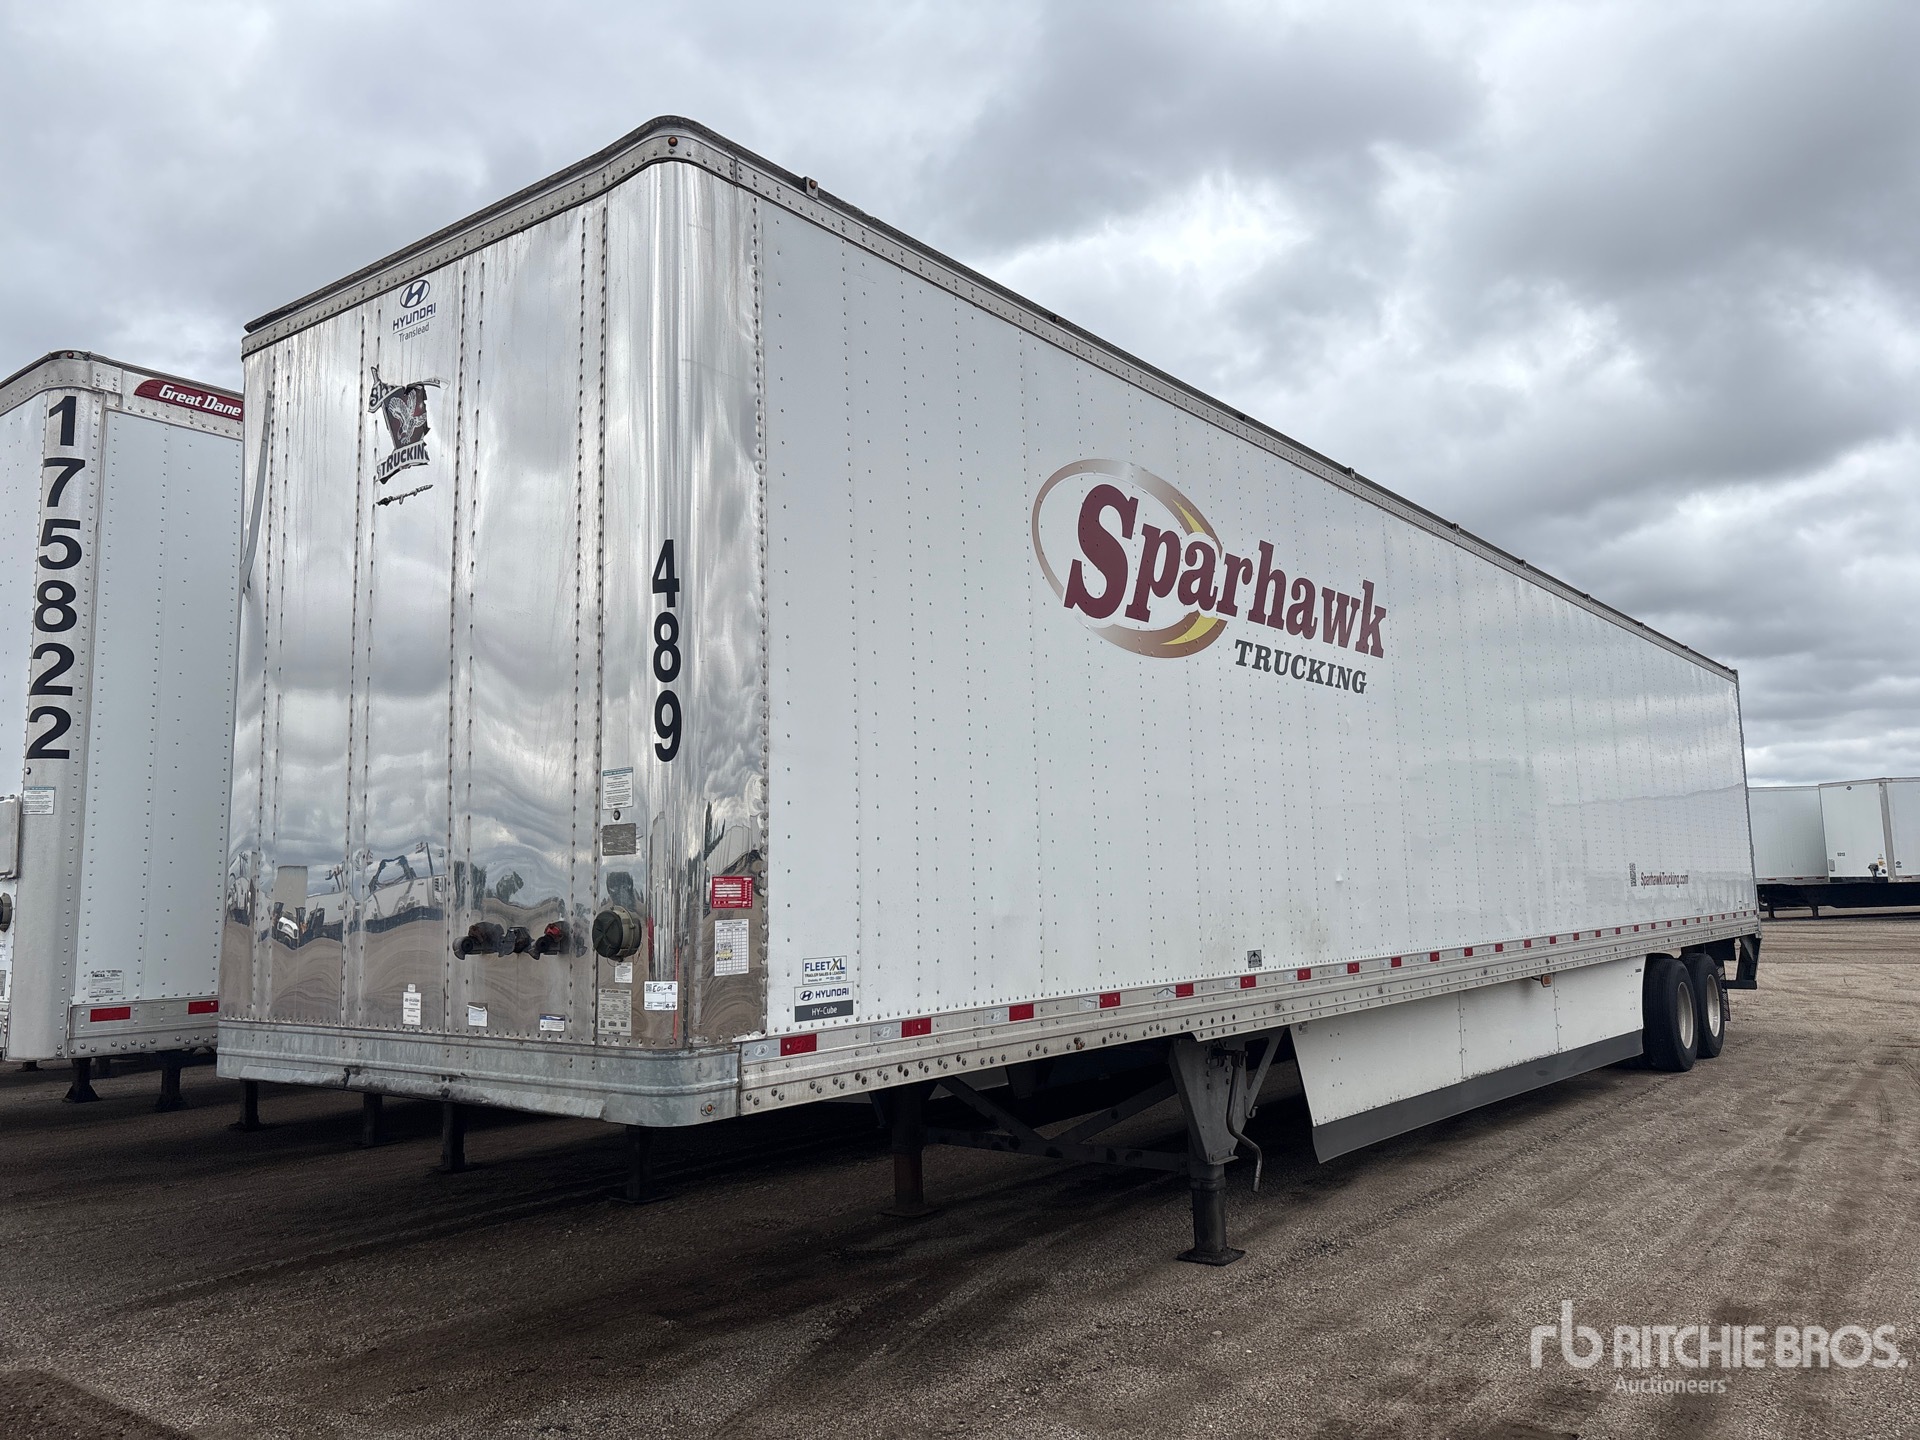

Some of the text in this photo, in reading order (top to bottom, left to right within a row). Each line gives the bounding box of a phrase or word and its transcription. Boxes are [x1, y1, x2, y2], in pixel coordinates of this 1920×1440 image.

[393, 302, 437, 331] HYUNDAI
[399, 321, 430, 343] Translead
[159, 384, 242, 416] Great Dane
[26, 395, 86, 760] 175822
[1063, 483, 1387, 659] Sparhawk
[652, 539, 682, 762] 489
[1234, 638, 1367, 694] TRUCKING
[1640, 871, 1689, 889] SparhawkTrucking.com
[815, 988, 849, 998] HYUNDAI
[811, 1006, 838, 1016] HY-Cube
